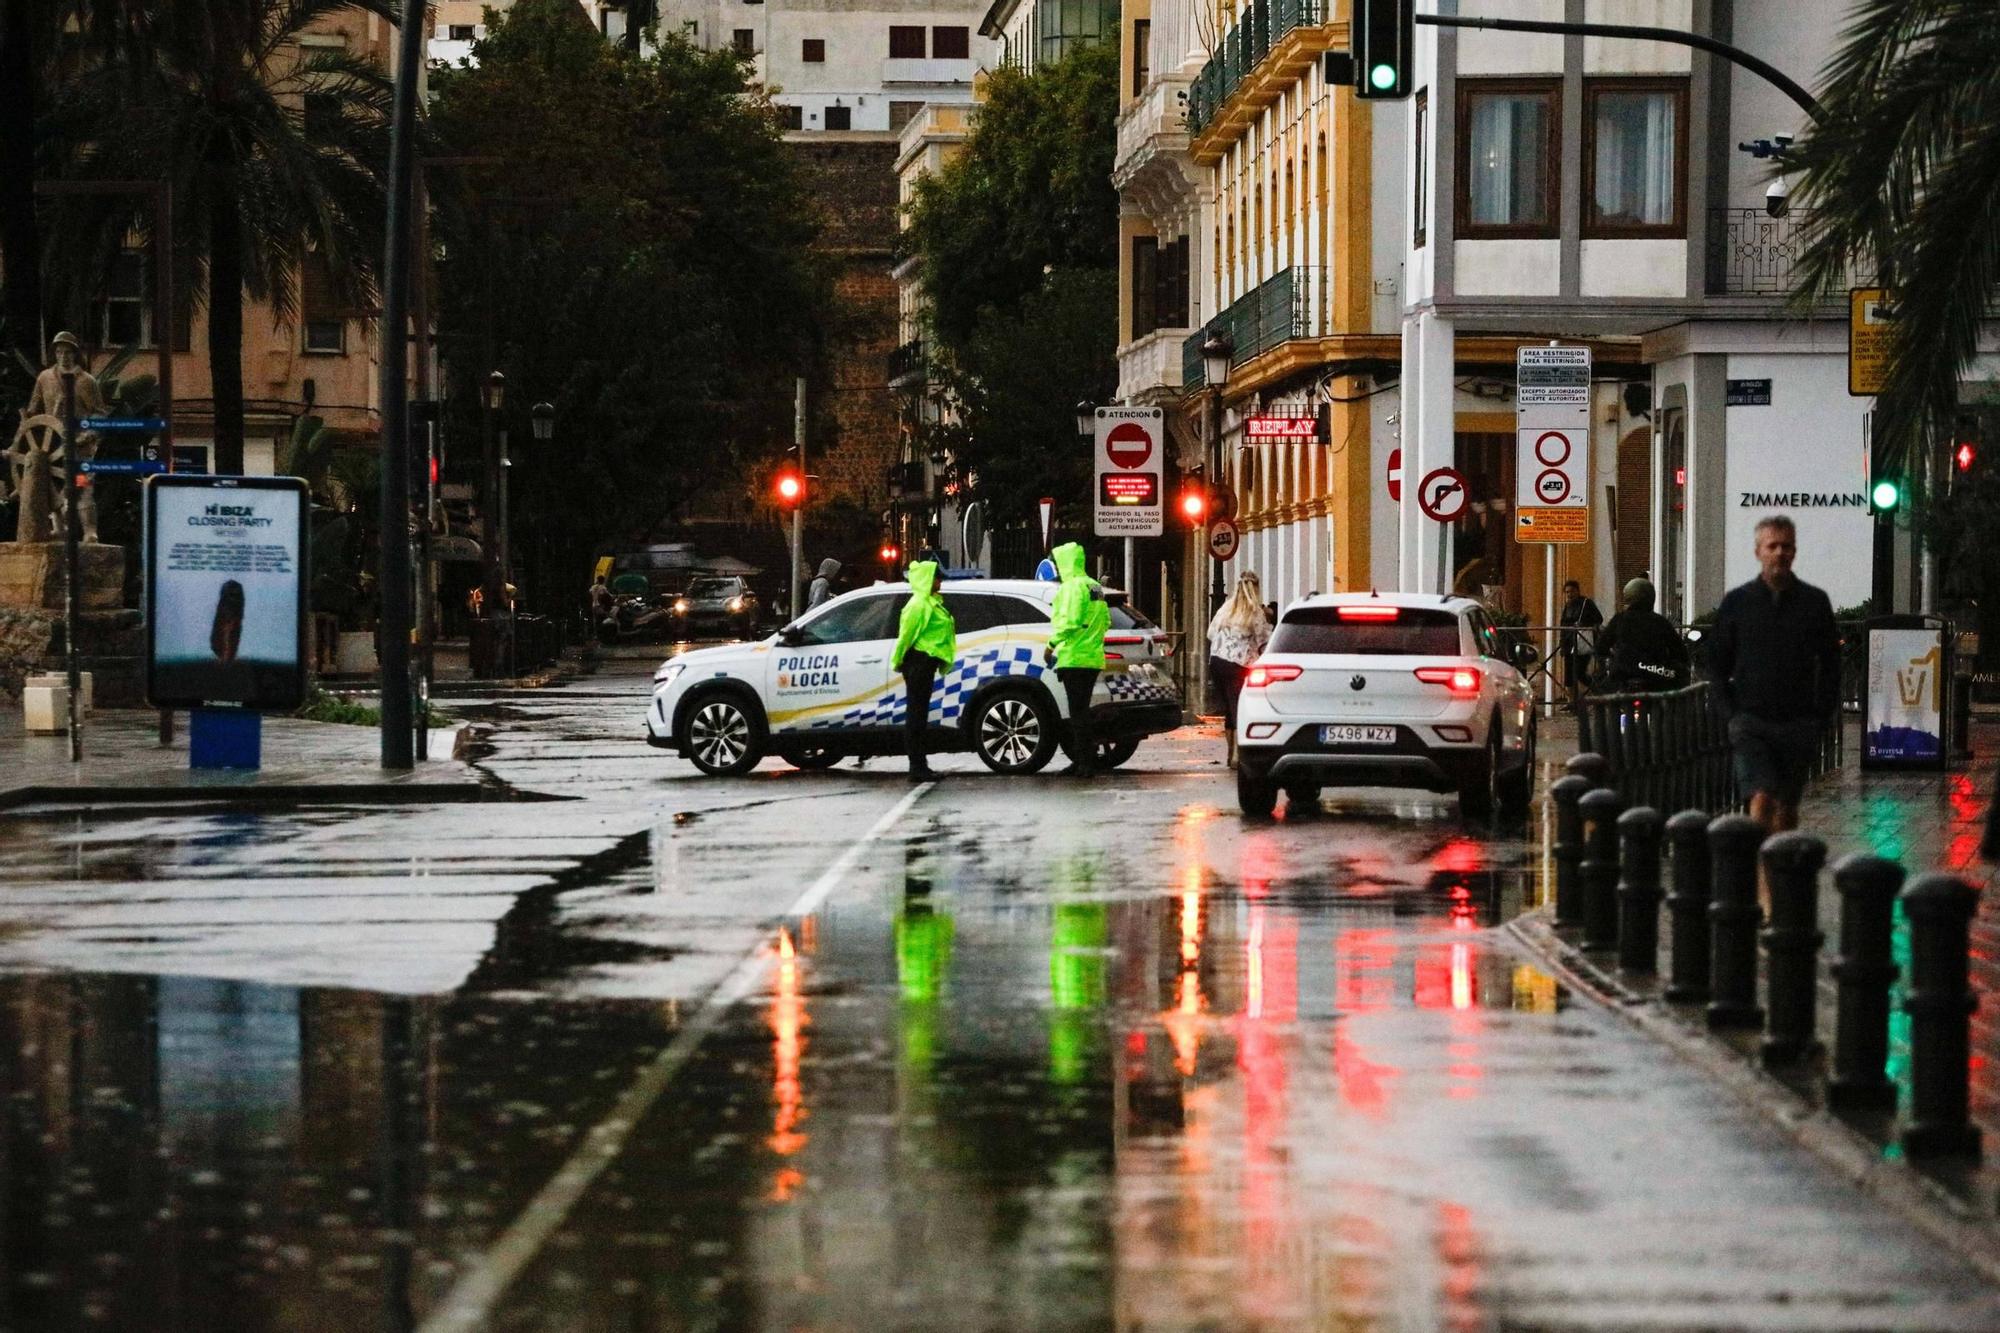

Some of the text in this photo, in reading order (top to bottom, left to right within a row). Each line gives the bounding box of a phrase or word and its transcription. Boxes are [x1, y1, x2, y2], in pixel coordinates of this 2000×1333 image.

[1249, 420, 1315, 434] REPLAY
[1740, 493, 1867, 507] ZIMMERMANN
[220, 506, 253, 516] IBIZA
[187, 516, 273, 527] CLOSING PARTY
[778, 655, 839, 671] POLICIA
[1871, 634, 1885, 694] ENVASES
[791, 672, 839, 687] LOCAL
[1329, 727, 1392, 741] 5496 MZX
